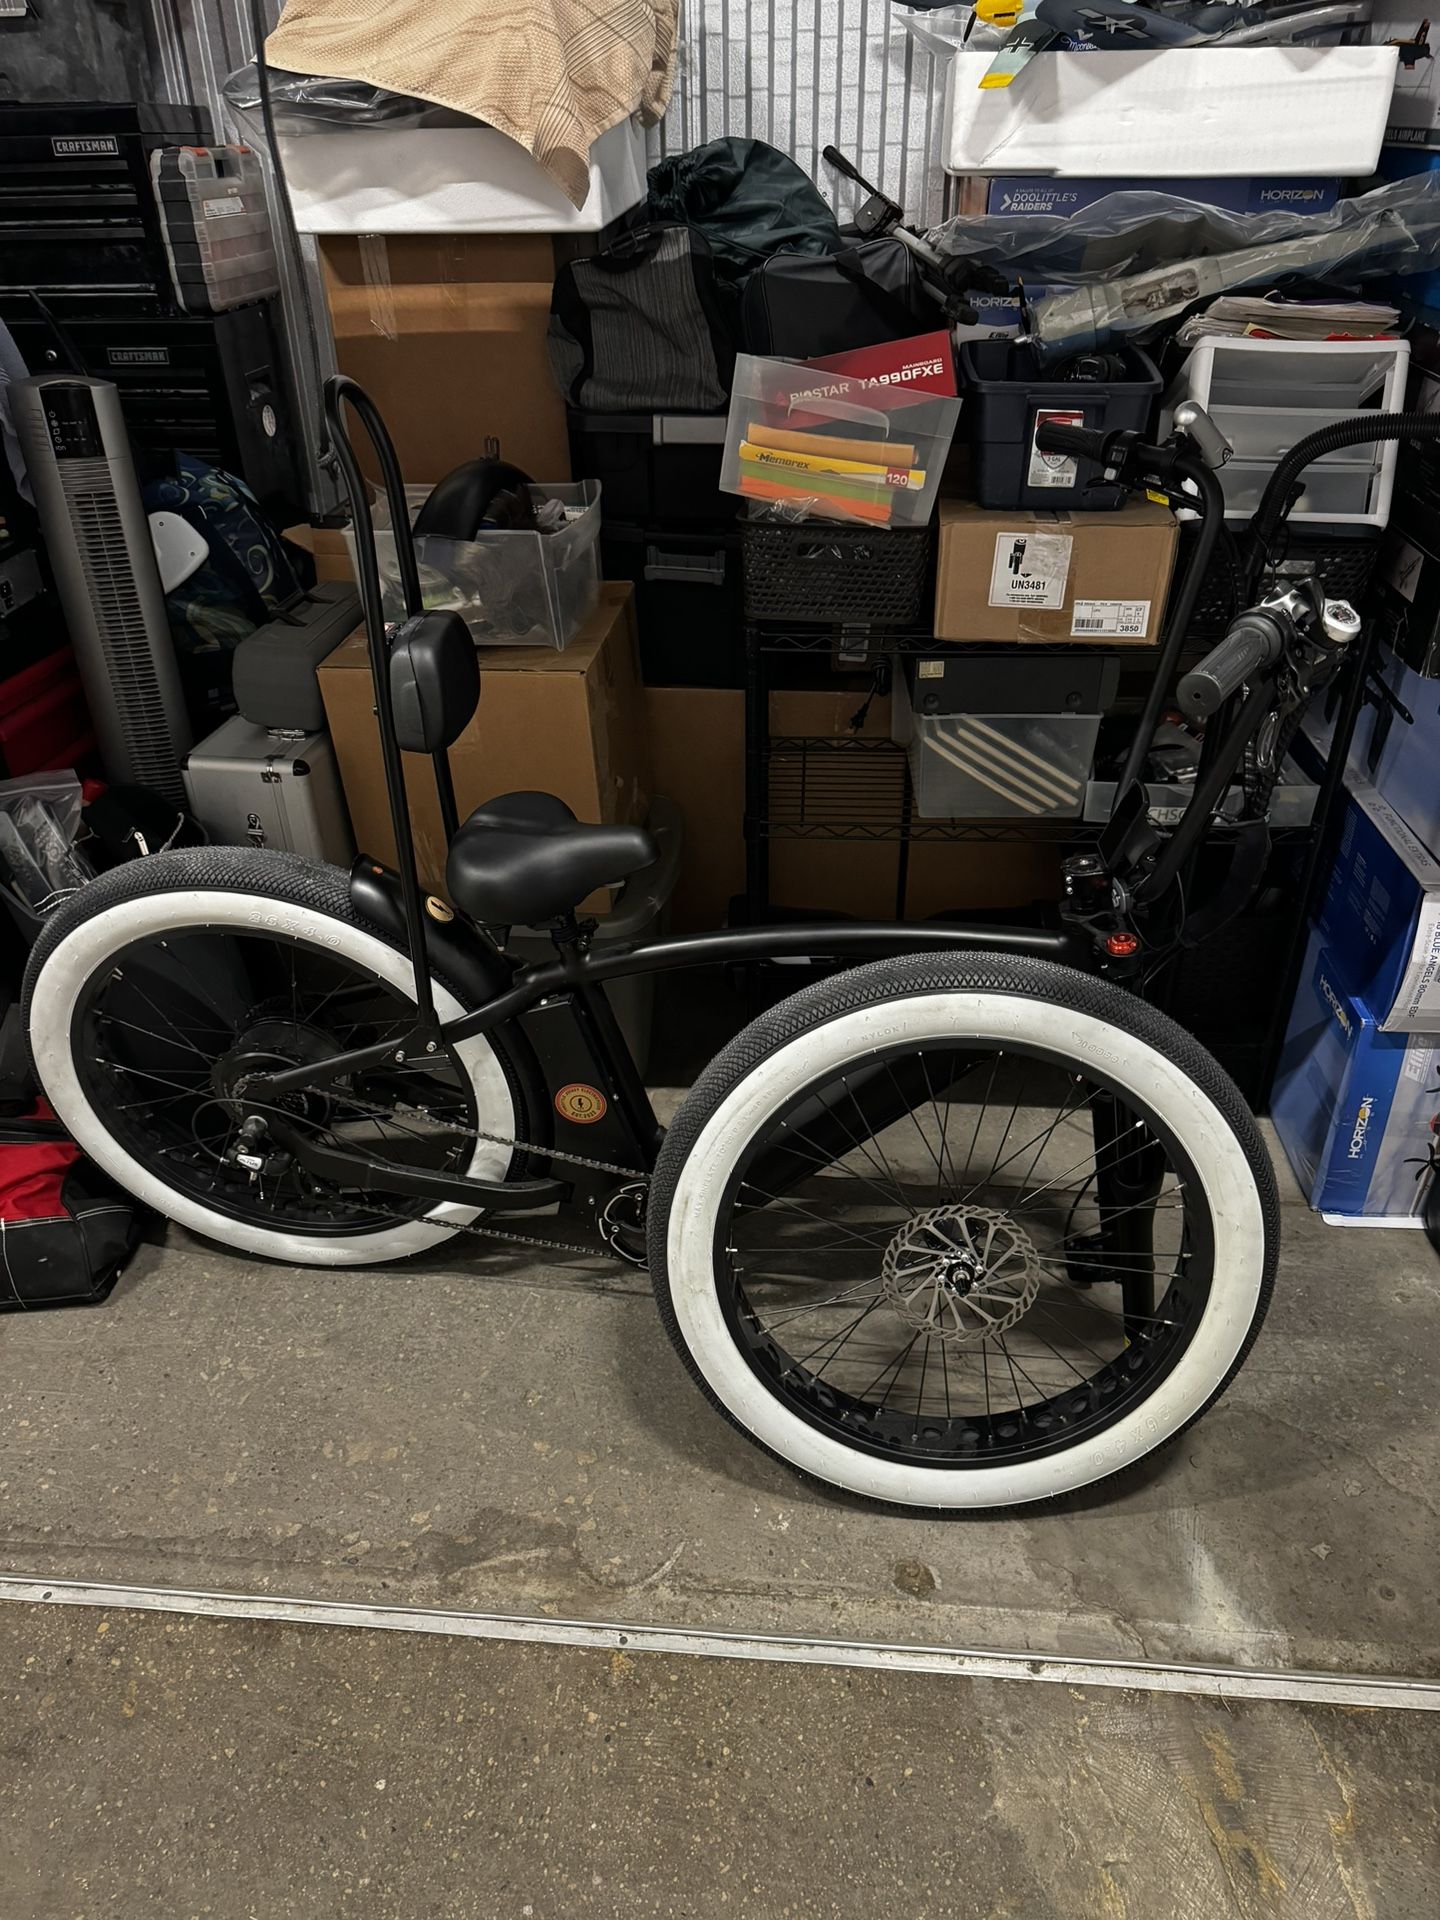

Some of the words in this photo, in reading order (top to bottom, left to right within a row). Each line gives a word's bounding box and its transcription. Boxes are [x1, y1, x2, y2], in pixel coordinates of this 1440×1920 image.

[56, 138, 114, 152] CRAFTSMAN
[1012, 192, 1078, 202] DOOLITTLE'S
[1260, 189, 1325, 200] HORIZON
[1010, 202, 1053, 211] RAIDERS
[111, 351, 165, 362] CRAFTSMAN
[902, 357, 943, 370] MAINBOARD
[858, 363, 944, 391] TA990FXE
[789, 383, 850, 402] BIOSTAR
[757, 452, 810, 470] Memorex
[886, 473, 908, 486] 120
[1011, 579, 1046, 591] UN3481
[1420, 954, 1438, 983] ANGELS
[1411, 984, 1427, 1005] 80mm
[1319, 974, 1353, 1041] HORIZON
[1408, 1006, 1419, 1018] EDF
[1347, 1096, 1374, 1159] HORIZON
